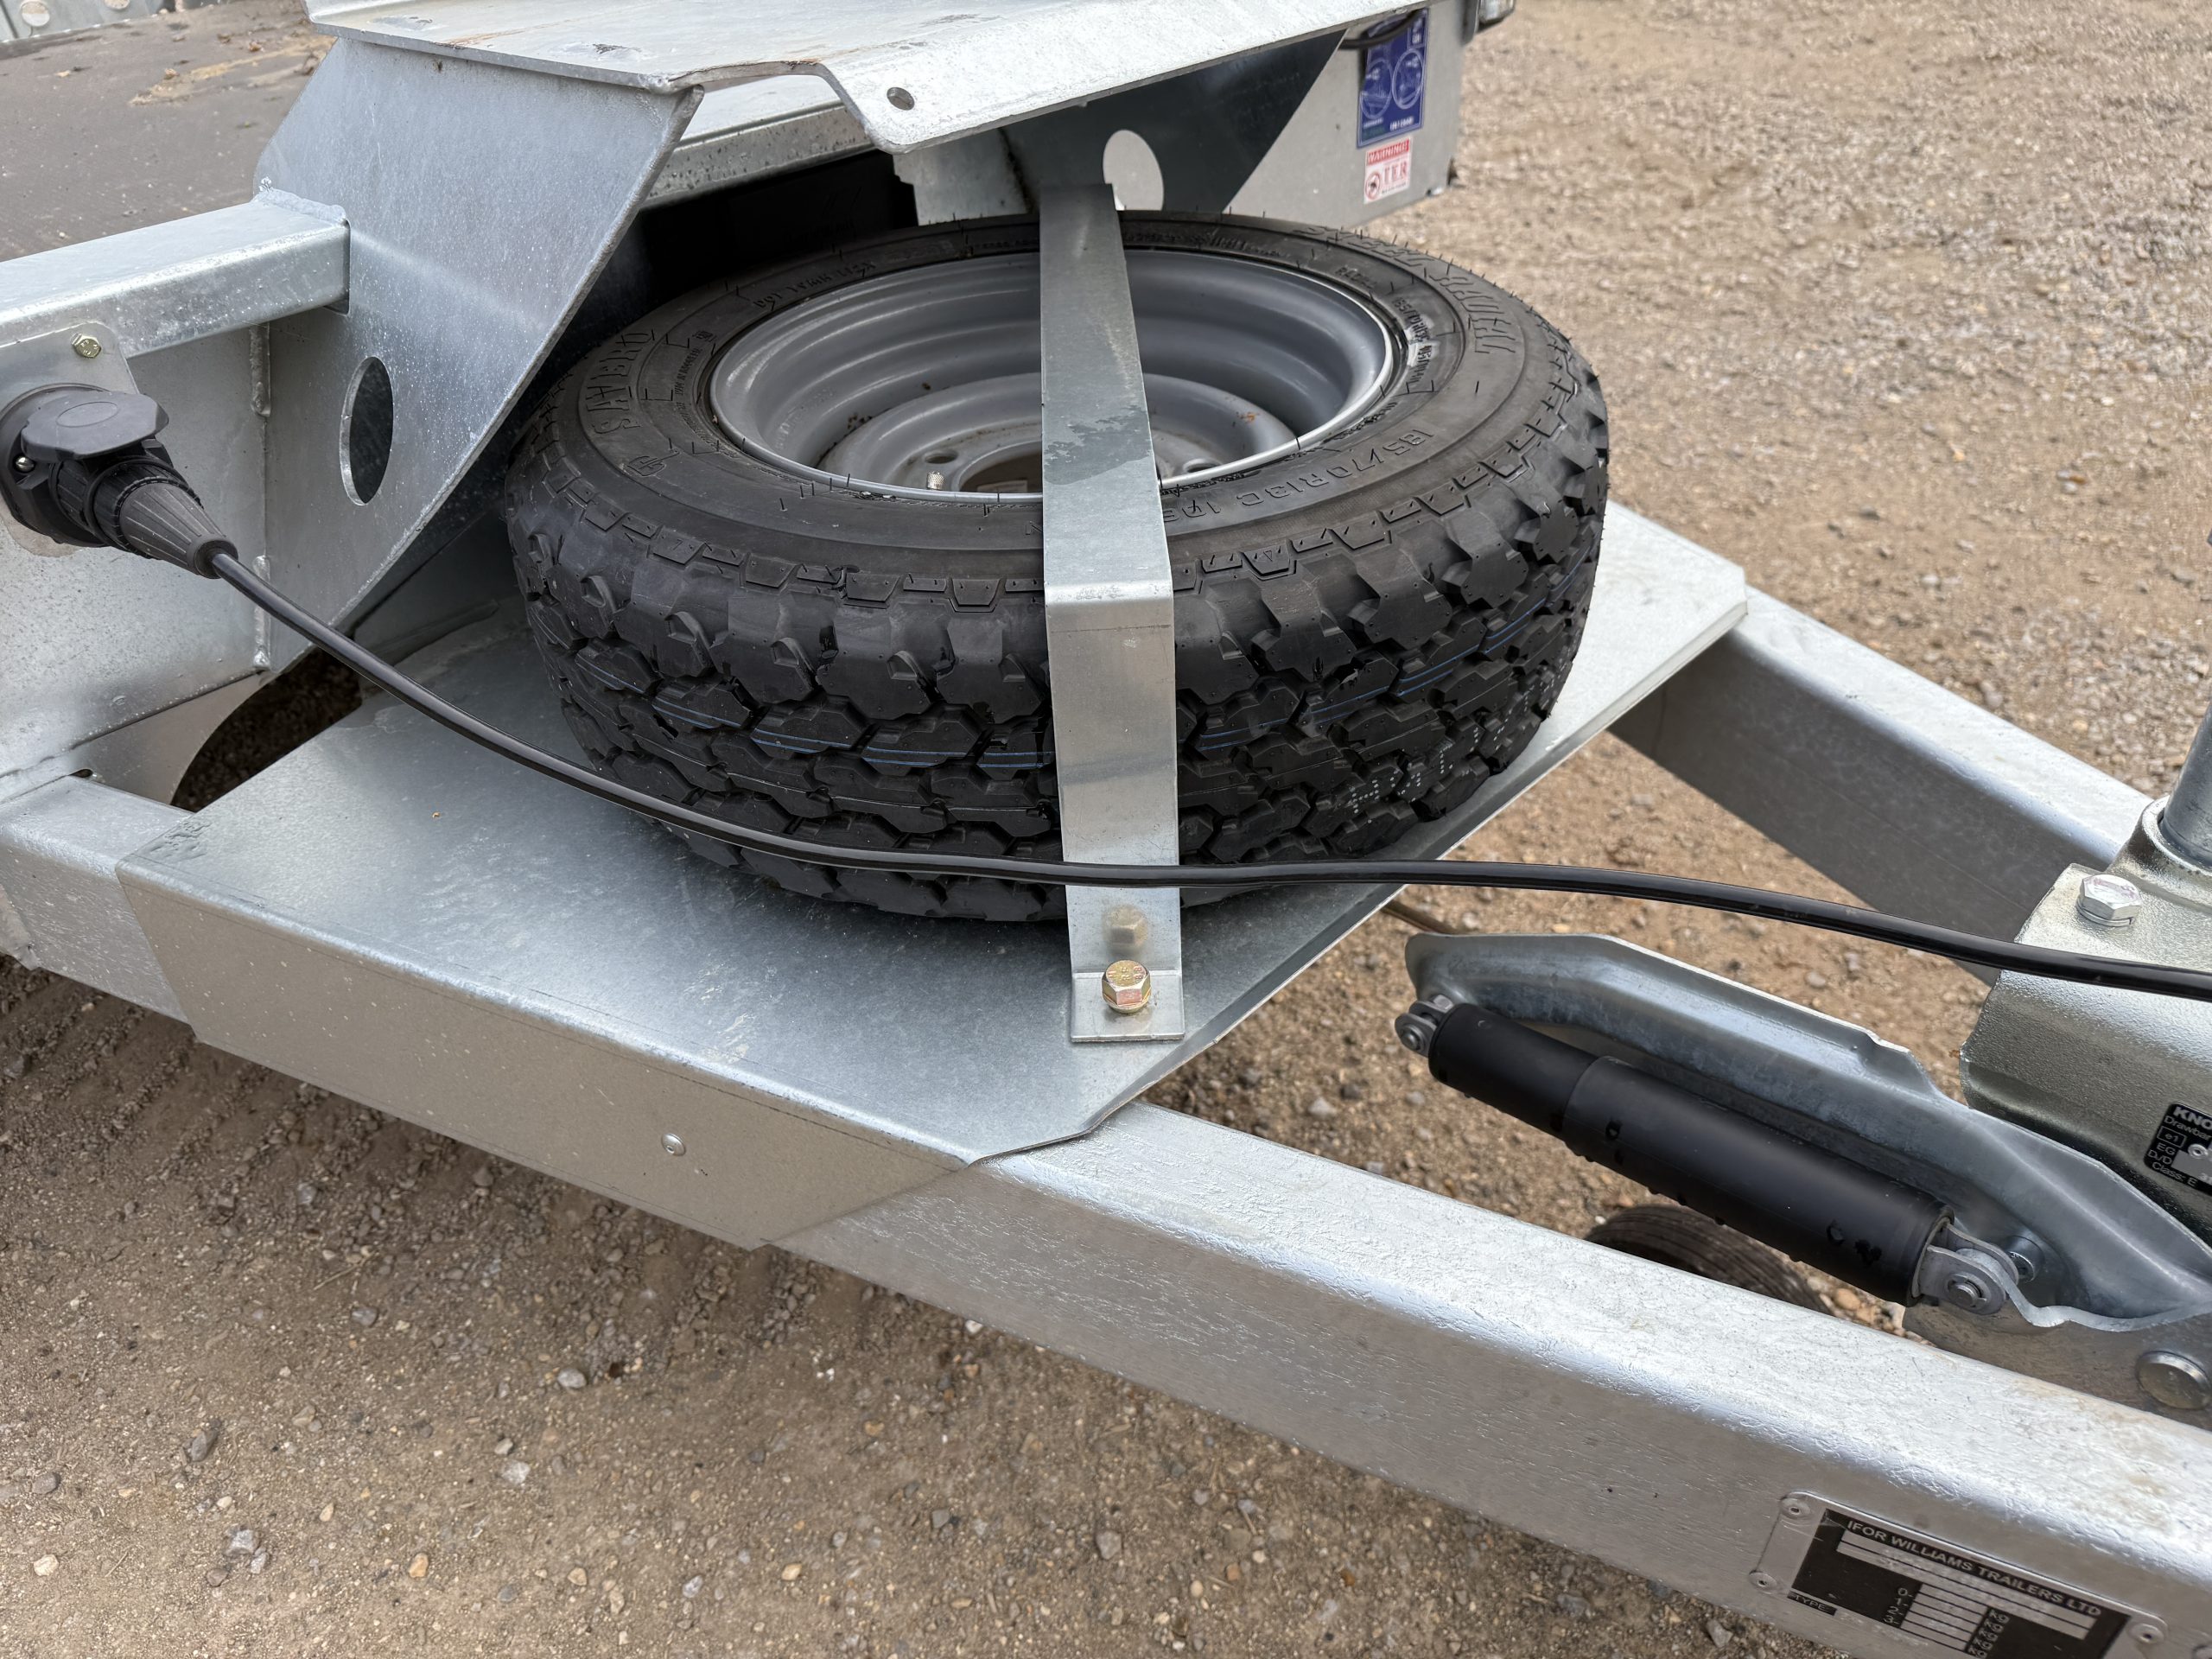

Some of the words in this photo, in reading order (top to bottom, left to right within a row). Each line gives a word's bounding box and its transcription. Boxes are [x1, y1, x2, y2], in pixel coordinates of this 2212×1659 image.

[2157, 1142, 2176, 1156] EG
[2187, 1176, 2198, 1188] E
[1847, 1520, 1887, 1541] IFOR
[1891, 1535, 1973, 1571] WILLIAMS
[1978, 1566, 2063, 1604] TRAILERS
[2066, 1599, 2102, 1616] LTD
[1796, 1595, 1827, 1611] TYPE
